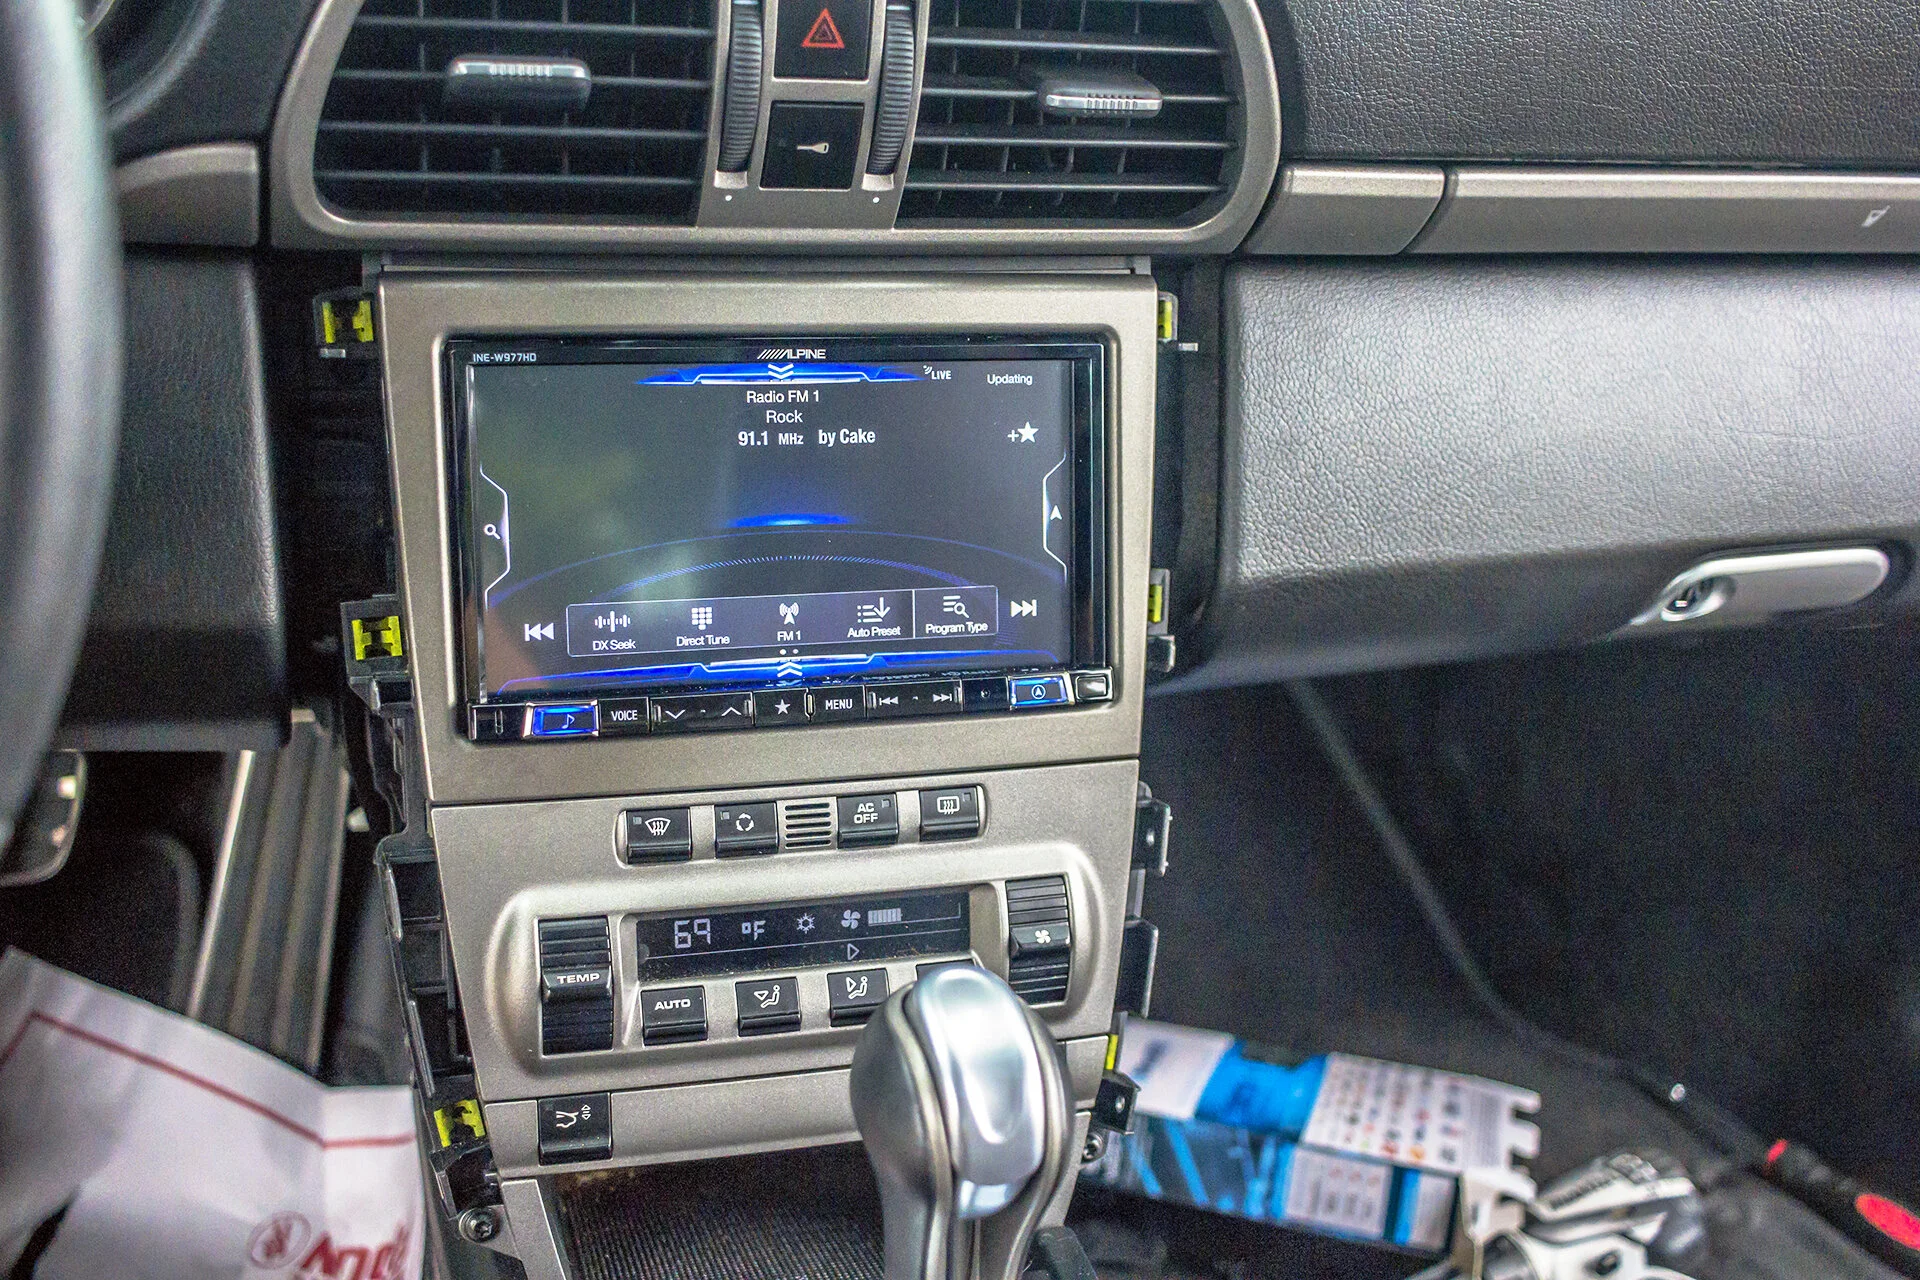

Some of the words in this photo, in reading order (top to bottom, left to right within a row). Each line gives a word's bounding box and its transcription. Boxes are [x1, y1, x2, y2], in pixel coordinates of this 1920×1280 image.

[473, 353, 537, 362] INE-W977HD
[773, 349, 827, 360] ALPINE
[931, 370, 952, 380] LIVE
[986, 374, 1033, 386] Updating
[746, 390, 785, 403] Radio
[788, 390, 809, 402] FM
[812, 390, 819, 402] 1
[766, 410, 804, 424] Rock
[738, 431, 769, 446] 91.1
[778, 432, 804, 445] MHz
[818, 429, 837, 447] by
[839, 428, 876, 444] Cake
[847, 627, 870, 638] Auto
[871, 626, 901, 637] Preset
[925, 623, 965, 635] Program
[965, 621, 989, 634] Type
[676, 635, 703, 647] Direct
[703, 634, 731, 646] Tune
[777, 630, 794, 642] FM
[795, 630, 801, 641] 1
[592, 640, 609, 651] DX
[610, 638, 636, 650] Seek
[825, 698, 853, 711] MENU
[611, 709, 638, 722] VOICE
[857, 802, 875, 813] AC
[853, 812, 879, 825] OFF
[674, 918, 711, 949] 69
[556, 972, 600, 985] TEMP
[654, 998, 691, 1011] AUTO
